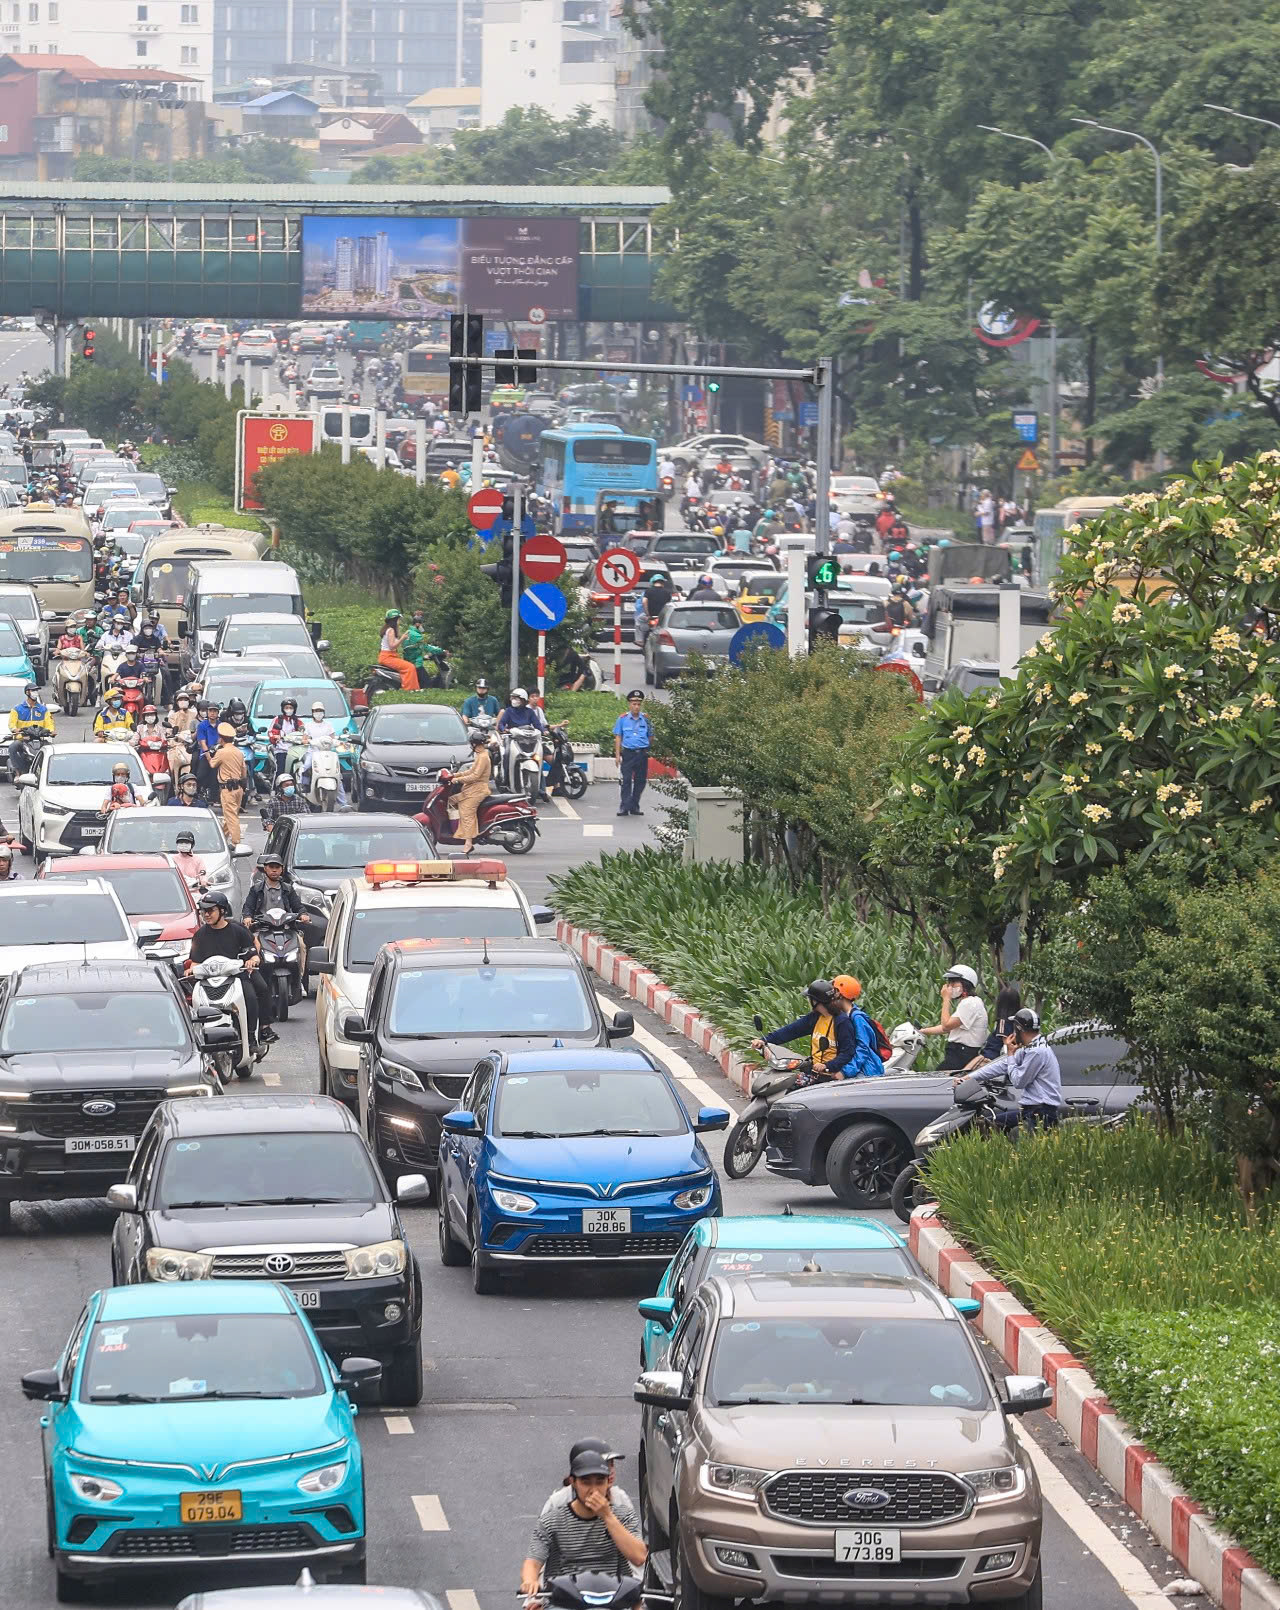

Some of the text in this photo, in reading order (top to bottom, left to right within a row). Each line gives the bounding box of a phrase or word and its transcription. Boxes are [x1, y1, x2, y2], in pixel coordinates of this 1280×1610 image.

[71, 1139, 130, 1151] 30M-058.51
[596, 1211, 617, 1221] 30K
[587, 1221, 626, 1233] 028.86
[99, 1343, 128, 1352] TAXI
[795, 1458, 939, 1468] EVEREST
[197, 1493, 222, 1505] 29E
[187, 1506, 235, 1521] 079.04
[854, 1531, 881, 1545] 30G
[842, 1547, 894, 1561] 773.89
